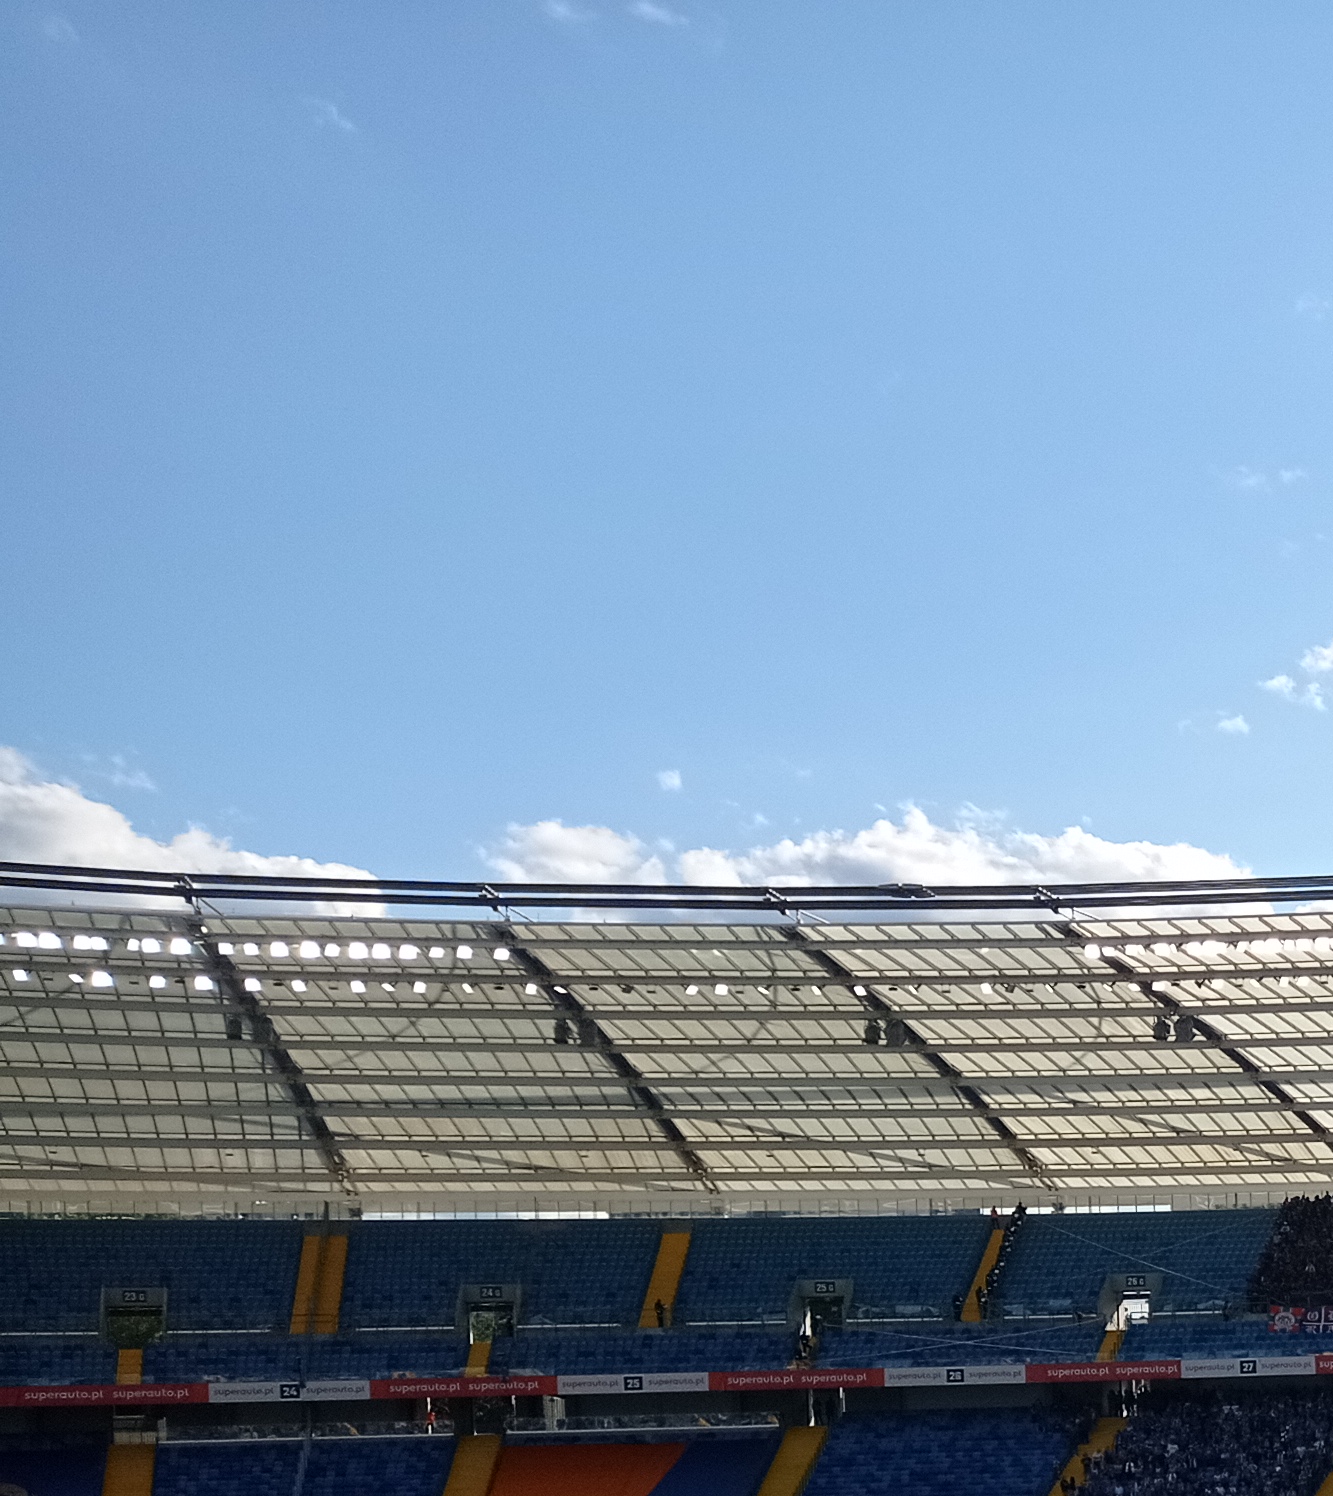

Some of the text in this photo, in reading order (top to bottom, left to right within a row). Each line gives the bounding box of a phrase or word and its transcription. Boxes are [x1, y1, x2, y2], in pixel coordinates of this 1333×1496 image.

[1242, 1362, 1255, 1372] 27
[626, 1377, 640, 1389] 25
[282, 1386, 297, 1397] 24
